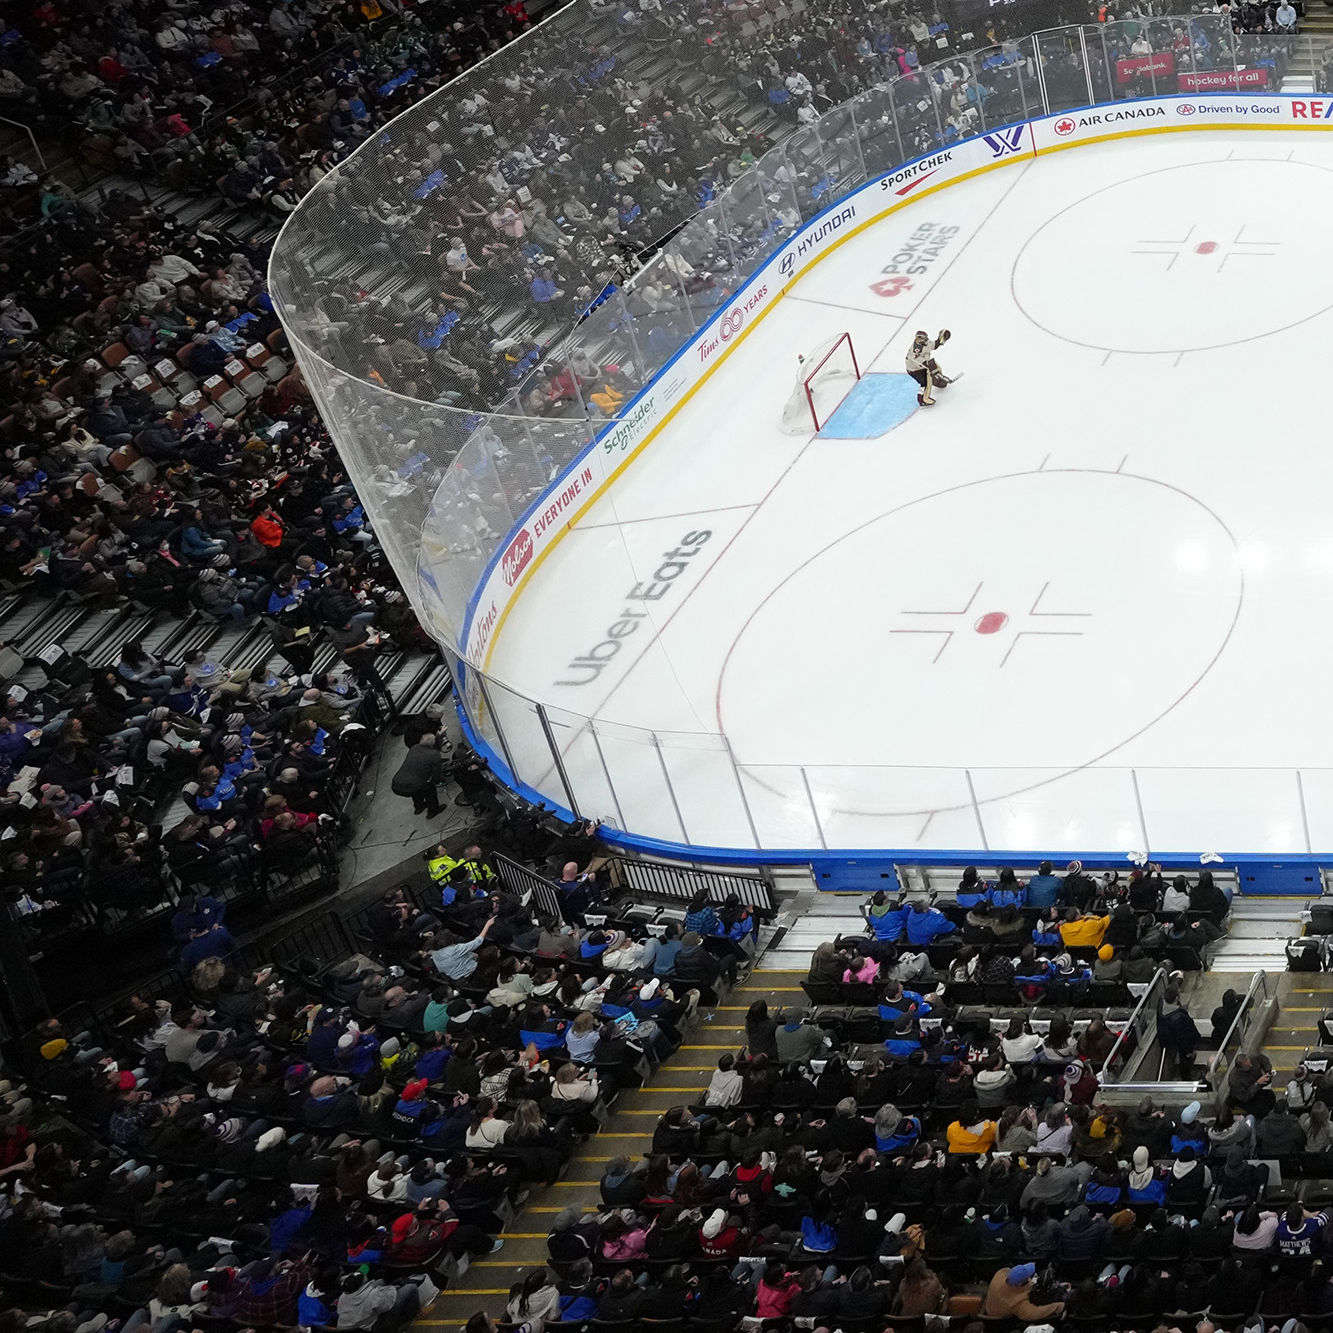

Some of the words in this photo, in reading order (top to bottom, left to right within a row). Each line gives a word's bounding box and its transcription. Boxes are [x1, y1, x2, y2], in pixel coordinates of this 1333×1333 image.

[1187, 75, 1227, 86] hockey
[1245, 72, 1259, 81] all
[1079, 115, 1101, 128] AIR
[1104, 106, 1166, 123] CANADA
[1198, 104, 1233, 115] Driven
[1235, 104, 1249, 117] by
[1251, 103, 1281, 115] Good
[880, 151, 953, 192] SPORTCHEK
[797, 205, 857, 258] HYUNDAI
[881, 221, 941, 276] POKER
[906, 224, 961, 276] STARS
[698, 336, 719, 363] Tims
[719, 304, 744, 342] 60
[743, 284, 769, 315] YEARS
[604, 395, 656, 454] Schneider
[629, 409, 658, 441] Electric
[533, 481, 583, 539] EVERYONE
[581, 467, 593, 487] IN
[553, 606, 648, 687] Uber
[626, 528, 713, 602] Eats
